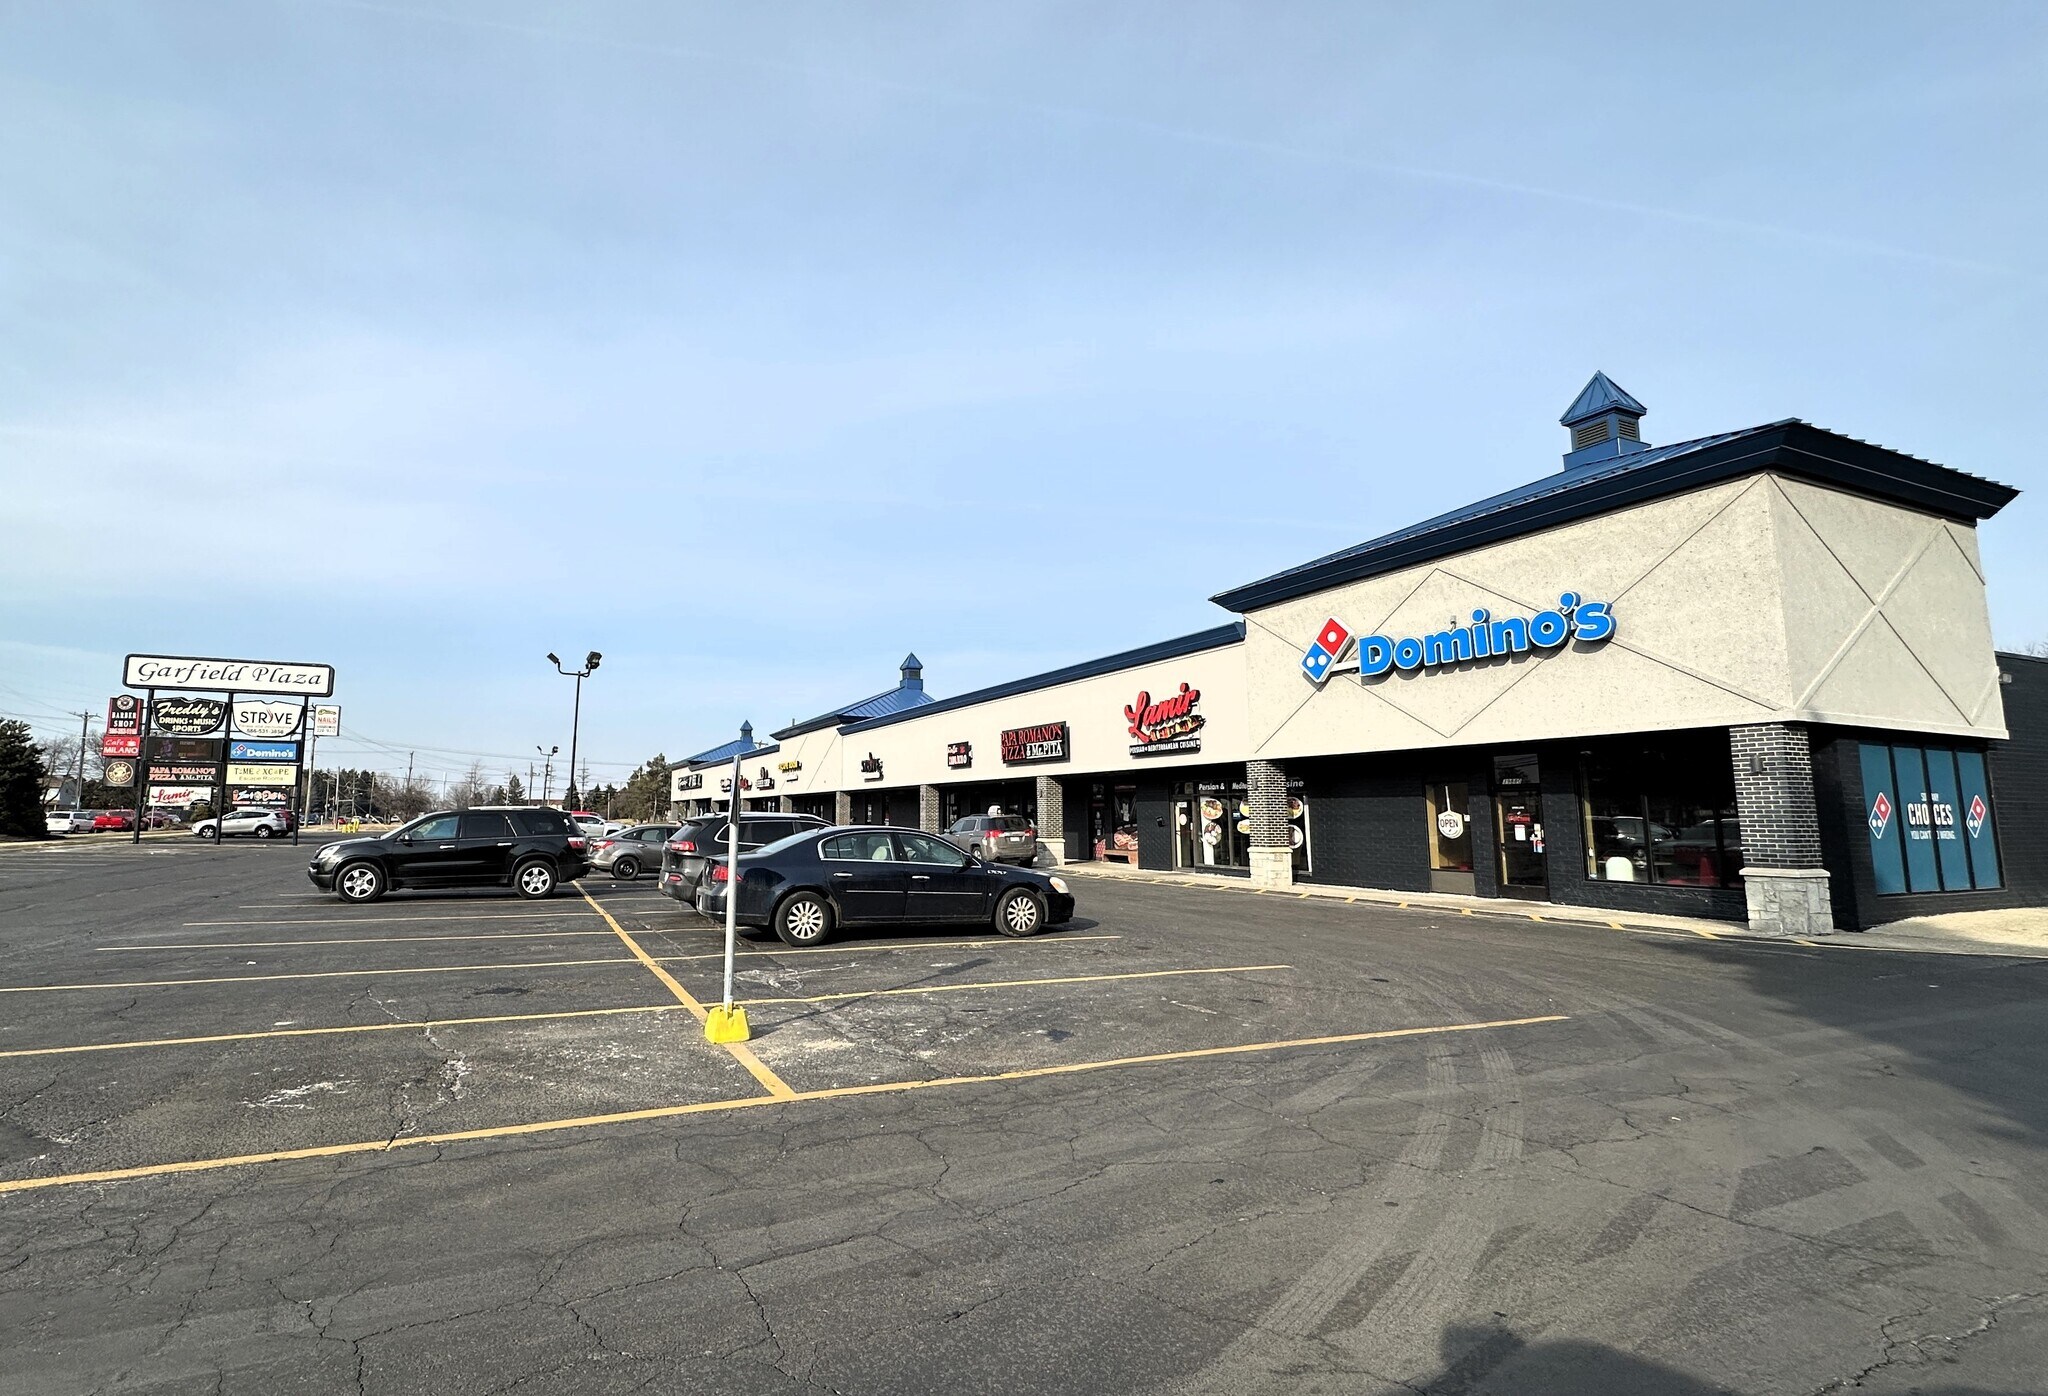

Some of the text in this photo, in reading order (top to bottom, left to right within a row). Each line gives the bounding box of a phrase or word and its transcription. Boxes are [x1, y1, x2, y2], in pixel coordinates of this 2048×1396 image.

[1357, 591, 1616, 677] Domino's
[138, 662, 322, 685] Garfield Plaza
[156, 702, 220, 718] Freddy's
[1124, 682, 1201, 743] Lamir
[111, 711, 137, 719] BARBER
[113, 720, 134, 728] SHOP
[158, 717, 217, 726] DRINKS MUSIC
[317, 716, 337, 724] NAILS
[171, 725, 202, 733] SPORTS
[1000, 725, 1062, 747] PAPA ROMANO'S
[105, 738, 125, 746] Cafe
[103, 746, 139, 754] MILANO
[246, 748, 294, 758] Domino's
[1001, 745, 1026, 761] PIZZA
[149, 766, 216, 775] PAPA ROMANO'S
[148, 773, 177, 781] PIZZA
[1198, 782, 1218, 791] Persian
[1218, 782, 1225, 790] &
[151, 788, 195, 803] Lamir
[1907, 802, 1954, 826] CHOCES
[1439, 818, 1459, 828] OPEN
